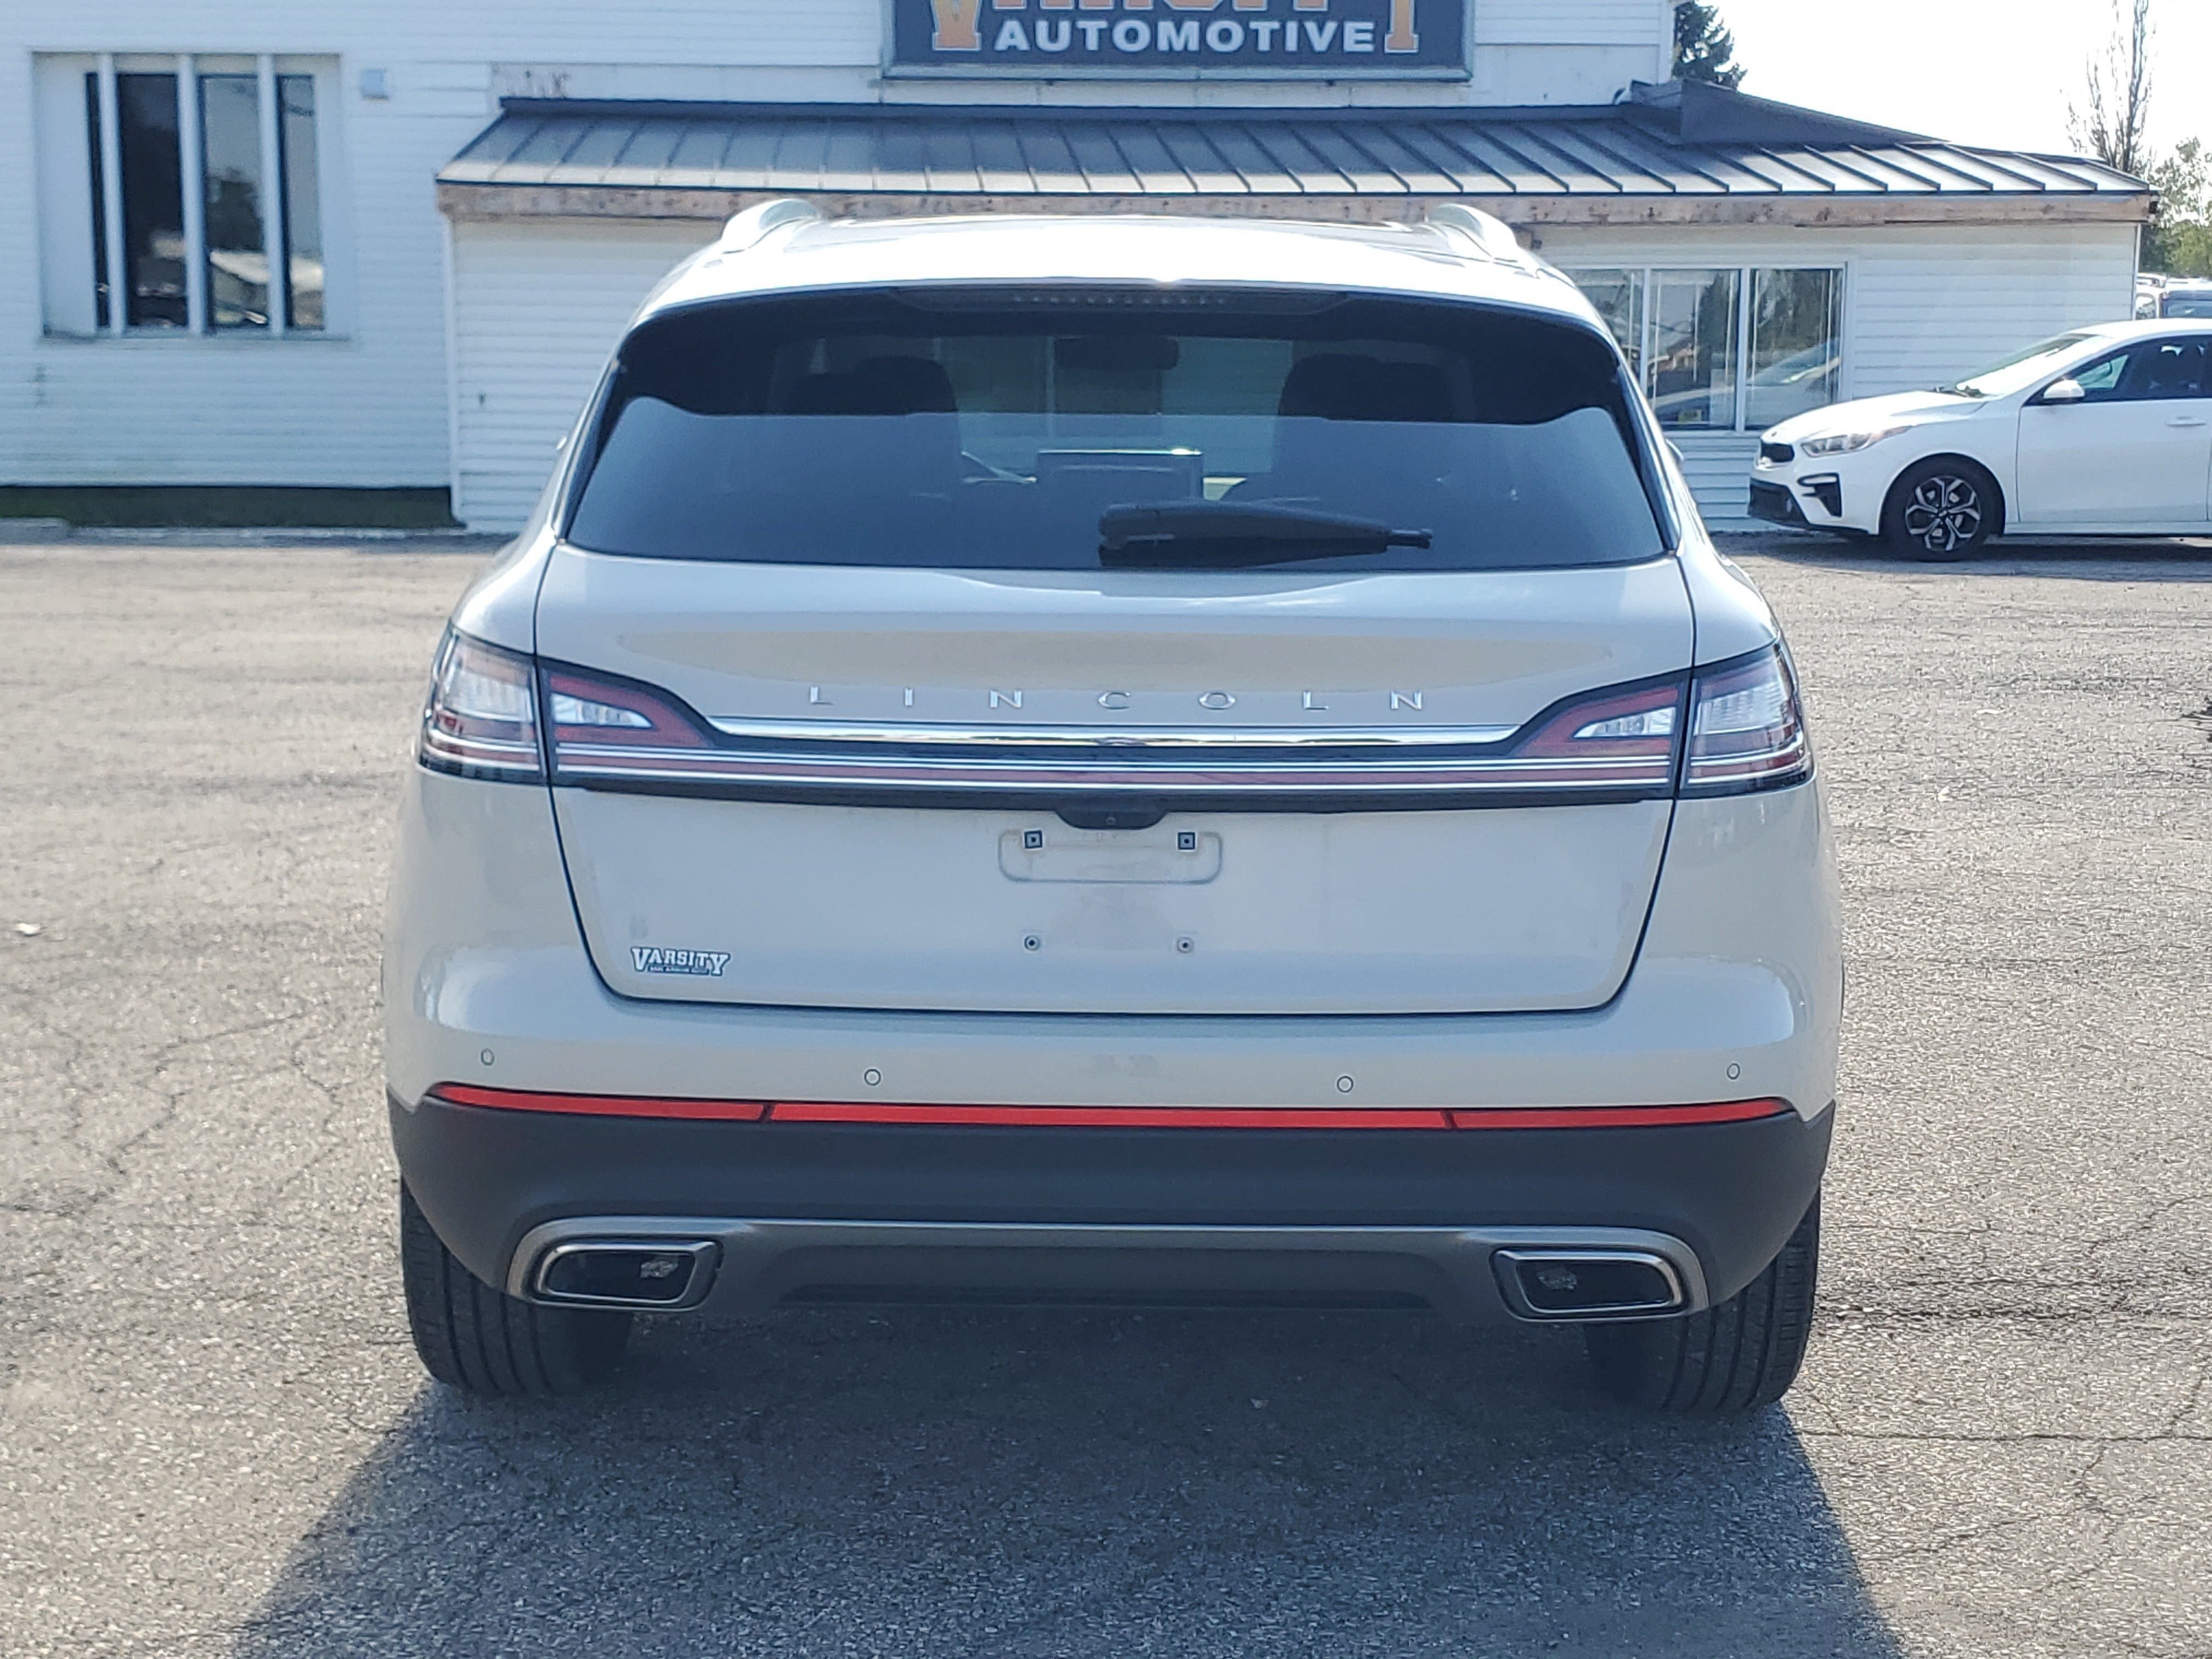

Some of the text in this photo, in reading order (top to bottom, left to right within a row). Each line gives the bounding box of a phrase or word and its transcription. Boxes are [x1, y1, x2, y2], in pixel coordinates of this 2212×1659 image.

[994, 19, 1375, 52] AUTOMOTIVE
[809, 686, 1423, 710] LINCOLN
[631, 947, 730, 975] VARSITY
